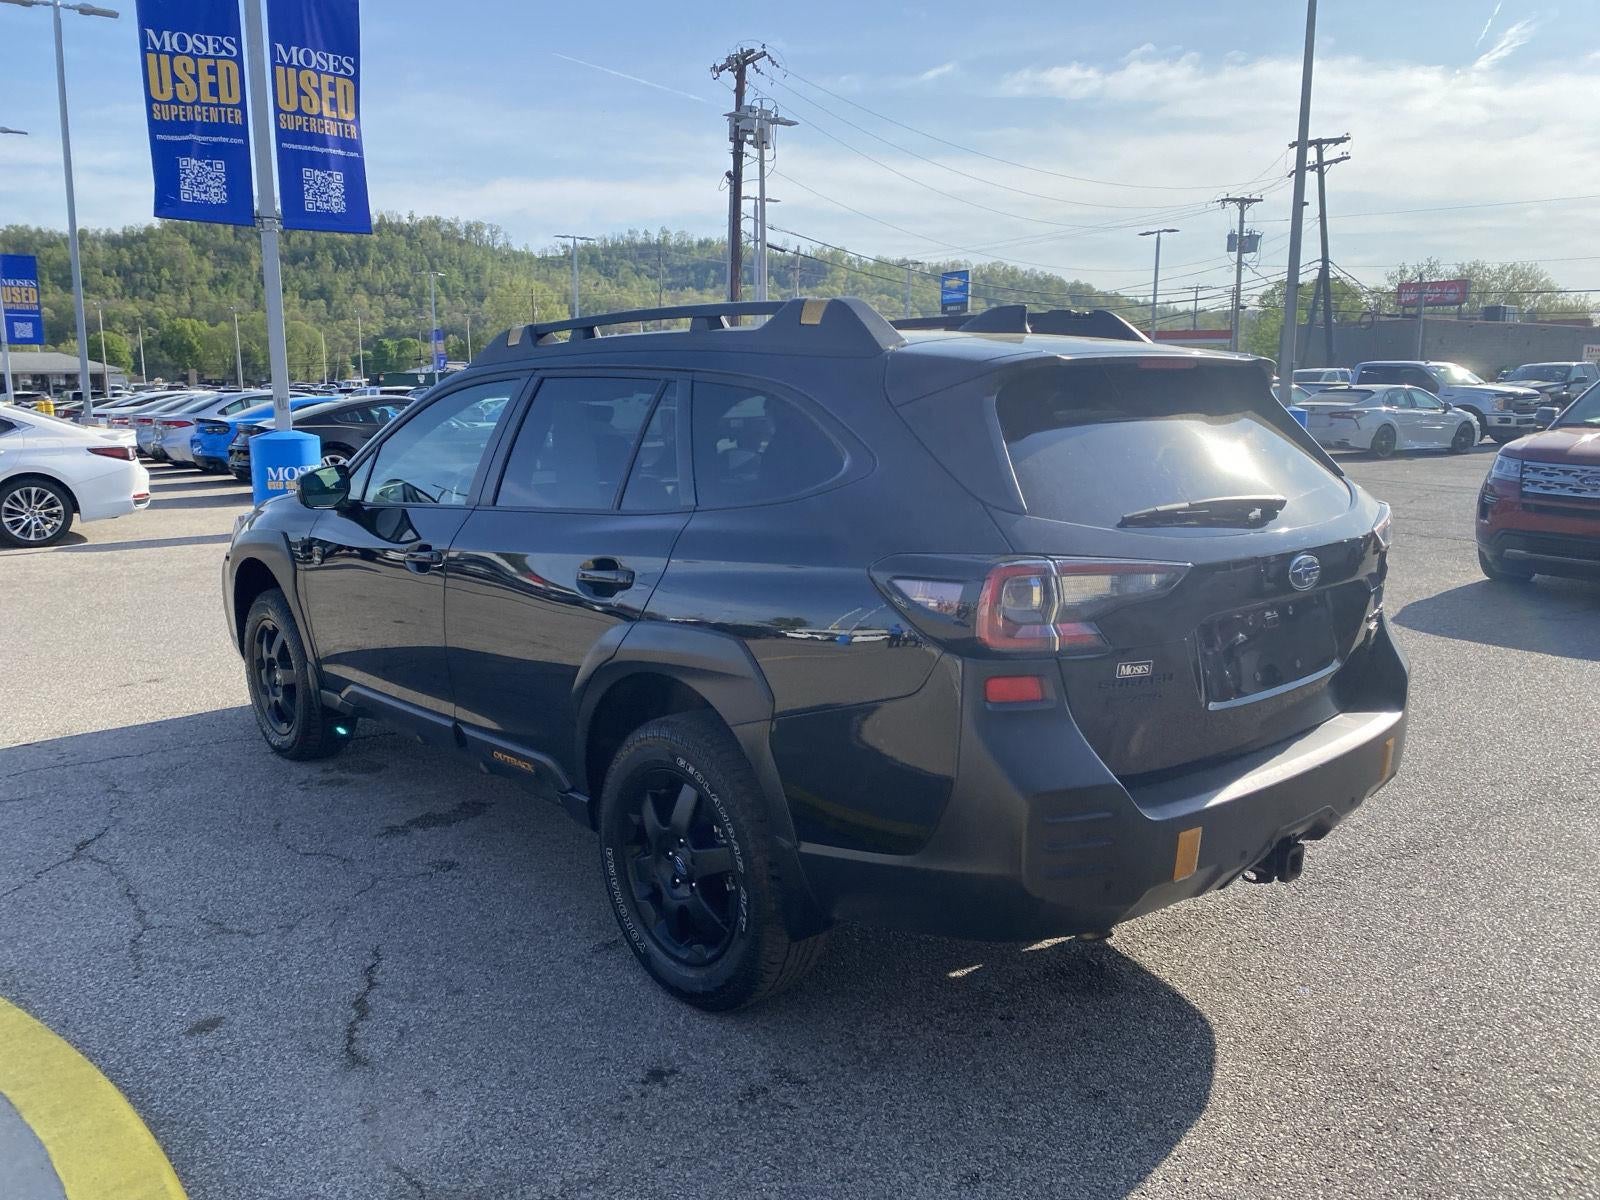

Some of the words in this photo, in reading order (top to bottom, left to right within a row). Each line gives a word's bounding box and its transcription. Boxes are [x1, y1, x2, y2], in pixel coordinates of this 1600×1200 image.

[145, 28, 237, 56] MOSES
[275, 43, 355, 76] MOSES
[146, 53, 241, 104] USED
[275, 66, 356, 121] USED
[152, 103, 242, 125] SUPERCENTER
[279, 113, 357, 140] SUPERCENTER
[156, 133, 244, 144] mosesusedsupercenter.com
[281, 142, 359, 158] mosesusedsupercenter.com
[1, 278, 37, 287] MOSES
[2, 286, 38, 303] USED
[1120, 664, 1149, 676] MOSES
